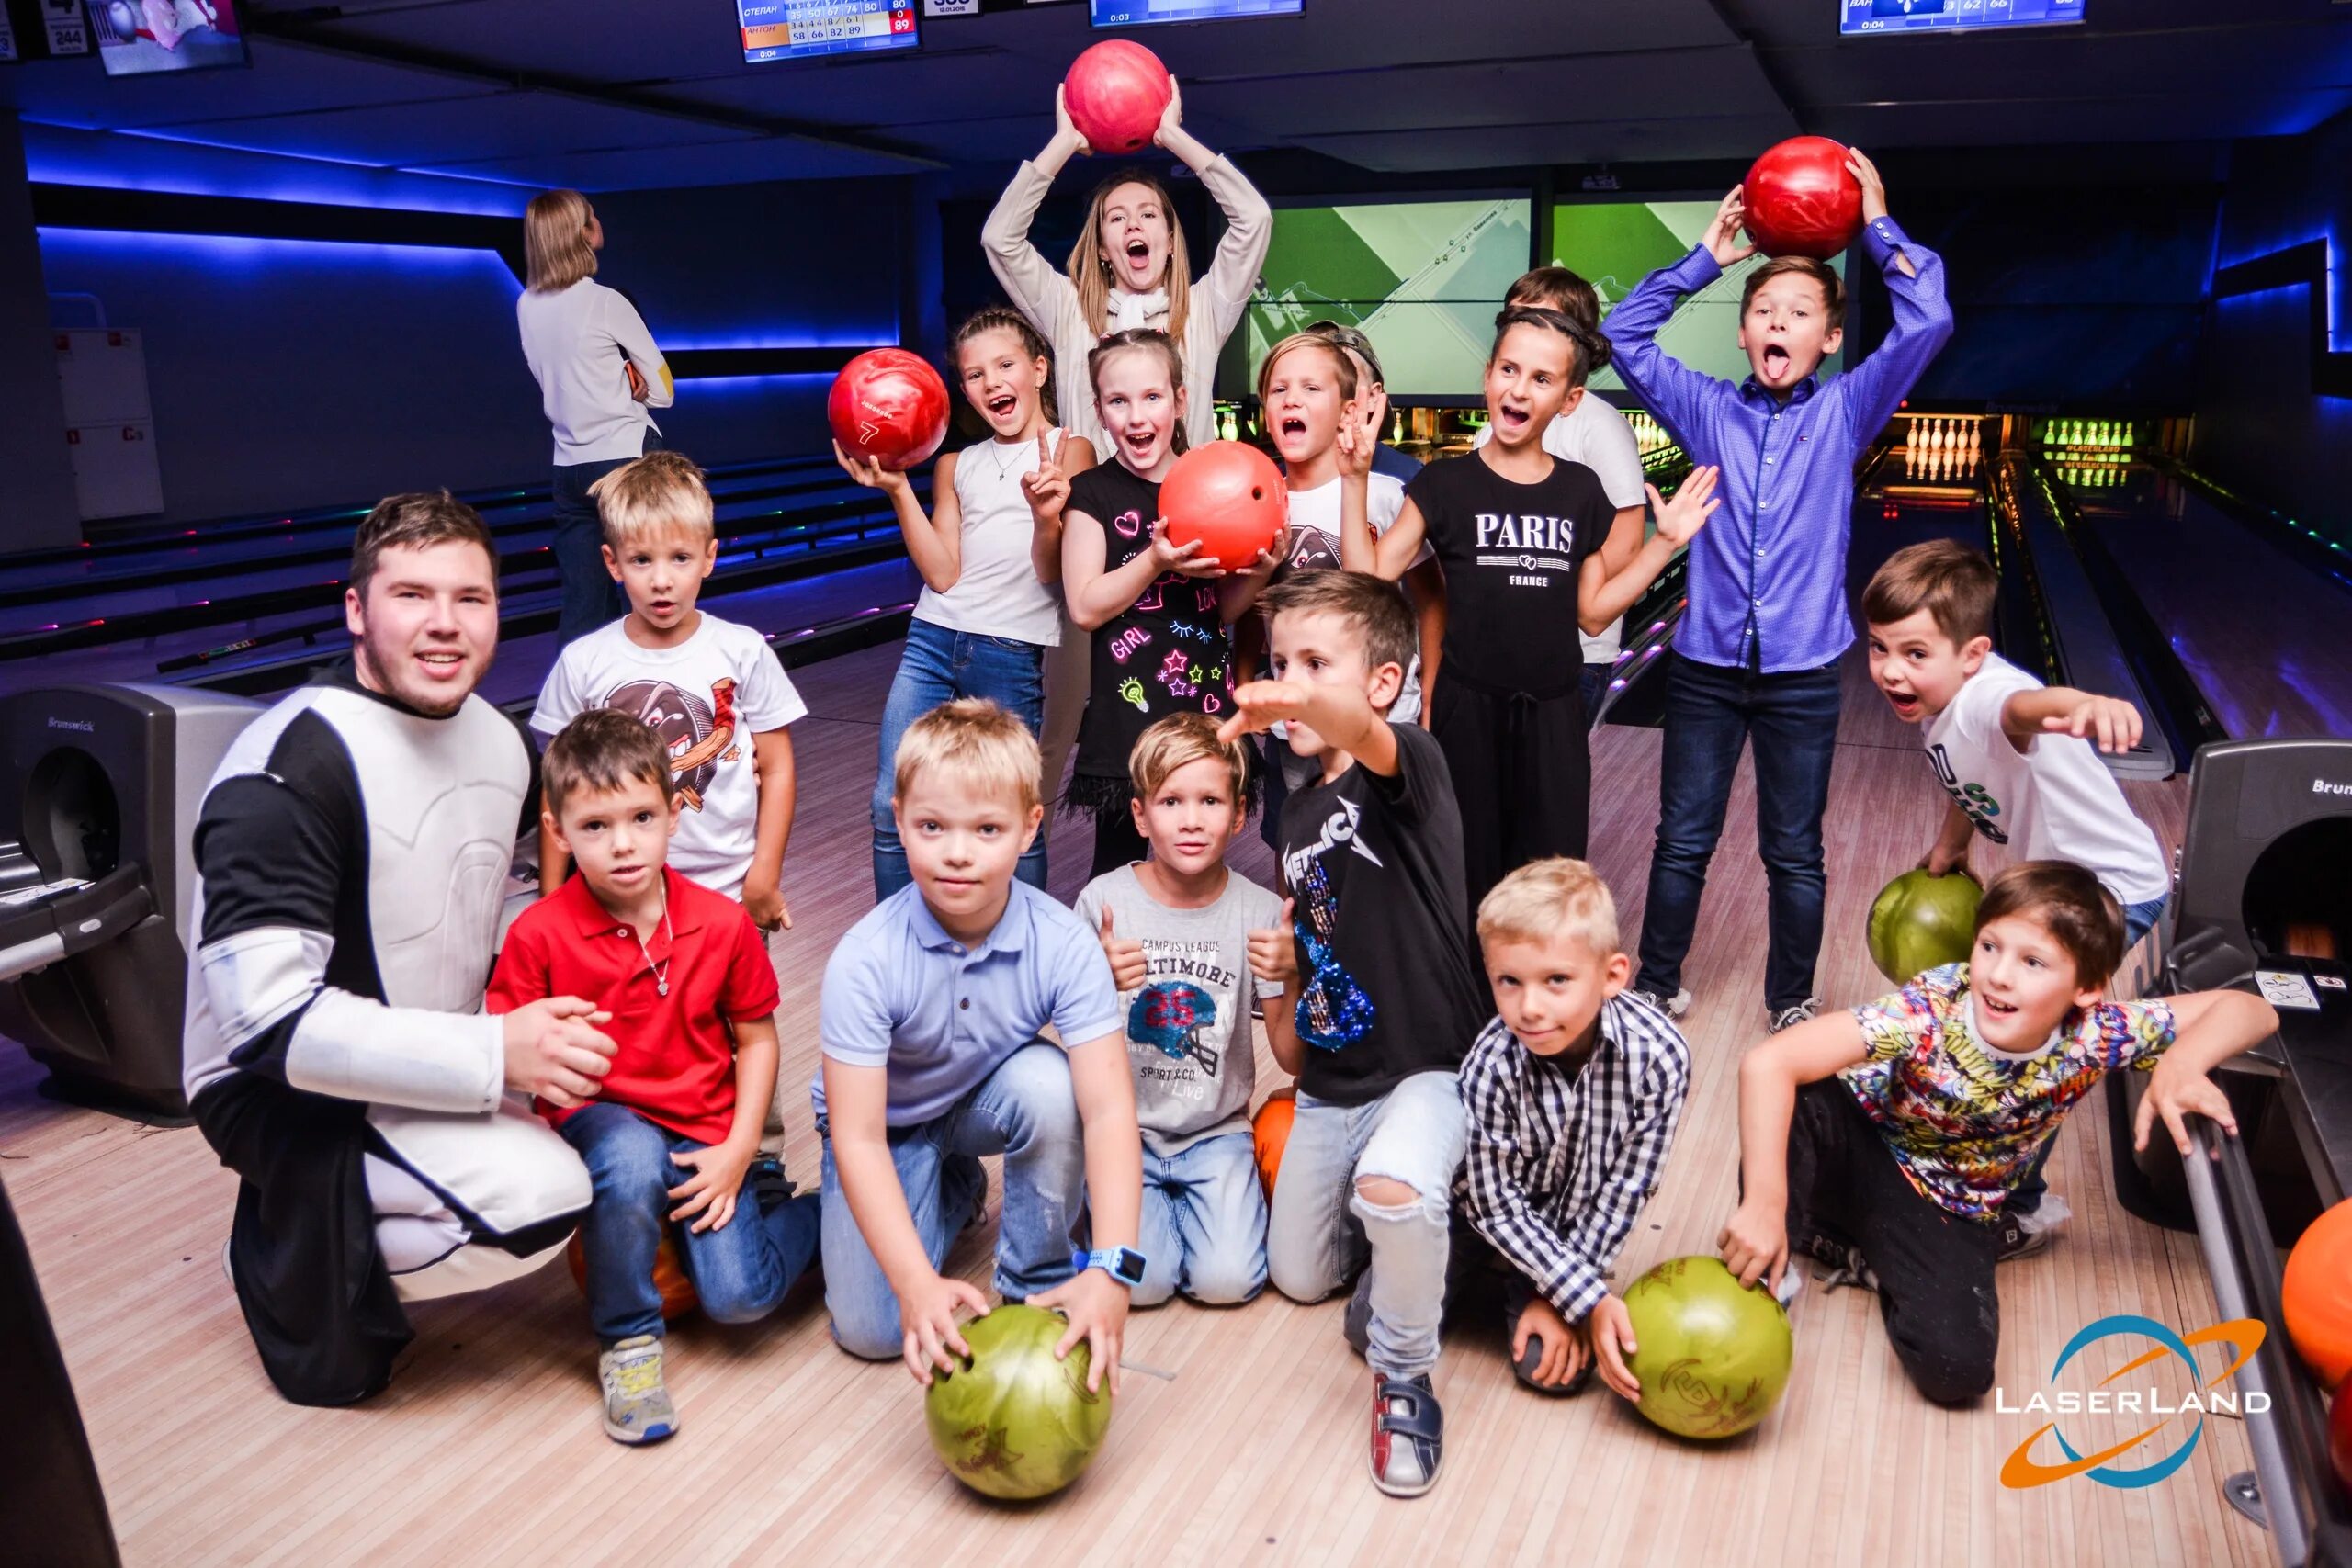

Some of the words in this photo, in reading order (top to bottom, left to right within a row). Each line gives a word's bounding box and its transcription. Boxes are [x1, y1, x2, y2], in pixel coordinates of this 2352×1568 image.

[743, 6, 777, 17] СТЕПАН
[791, 10, 802, 19] 35
[808, 9, 820, 17] 50
[828, 6, 839, 16] 67
[846, 5, 858, 14] 74
[865, 3, 877, 12] 80
[892, 0, 906, 8] 80
[1110, 13, 1130, 22] 0:03
[1861, 20, 1884, 29] 0:04
[747, 25, 780, 35] АНТОН
[895, 19, 910, 31] 89
[793, 32, 806, 40] 58
[811, 29, 824, 39] 66
[830, 28, 842, 37] 82
[848, 26, 861, 34] 89
[760, 50, 776, 59] 0:04
[859, 420, 880, 445] 7
[1475, 513, 1573, 554] PARIS
[1509, 575, 1549, 588] FRANCE
[1111, 626, 1151, 660] GIRL
[48, 716, 95, 732] Brunswick
[2312, 779, 2352, 795] Brun
[1142, 938, 1182, 953] CAMPUS
[1184, 940, 1220, 953] LEAGUE
[1144, 989, 1197, 1028] 25
